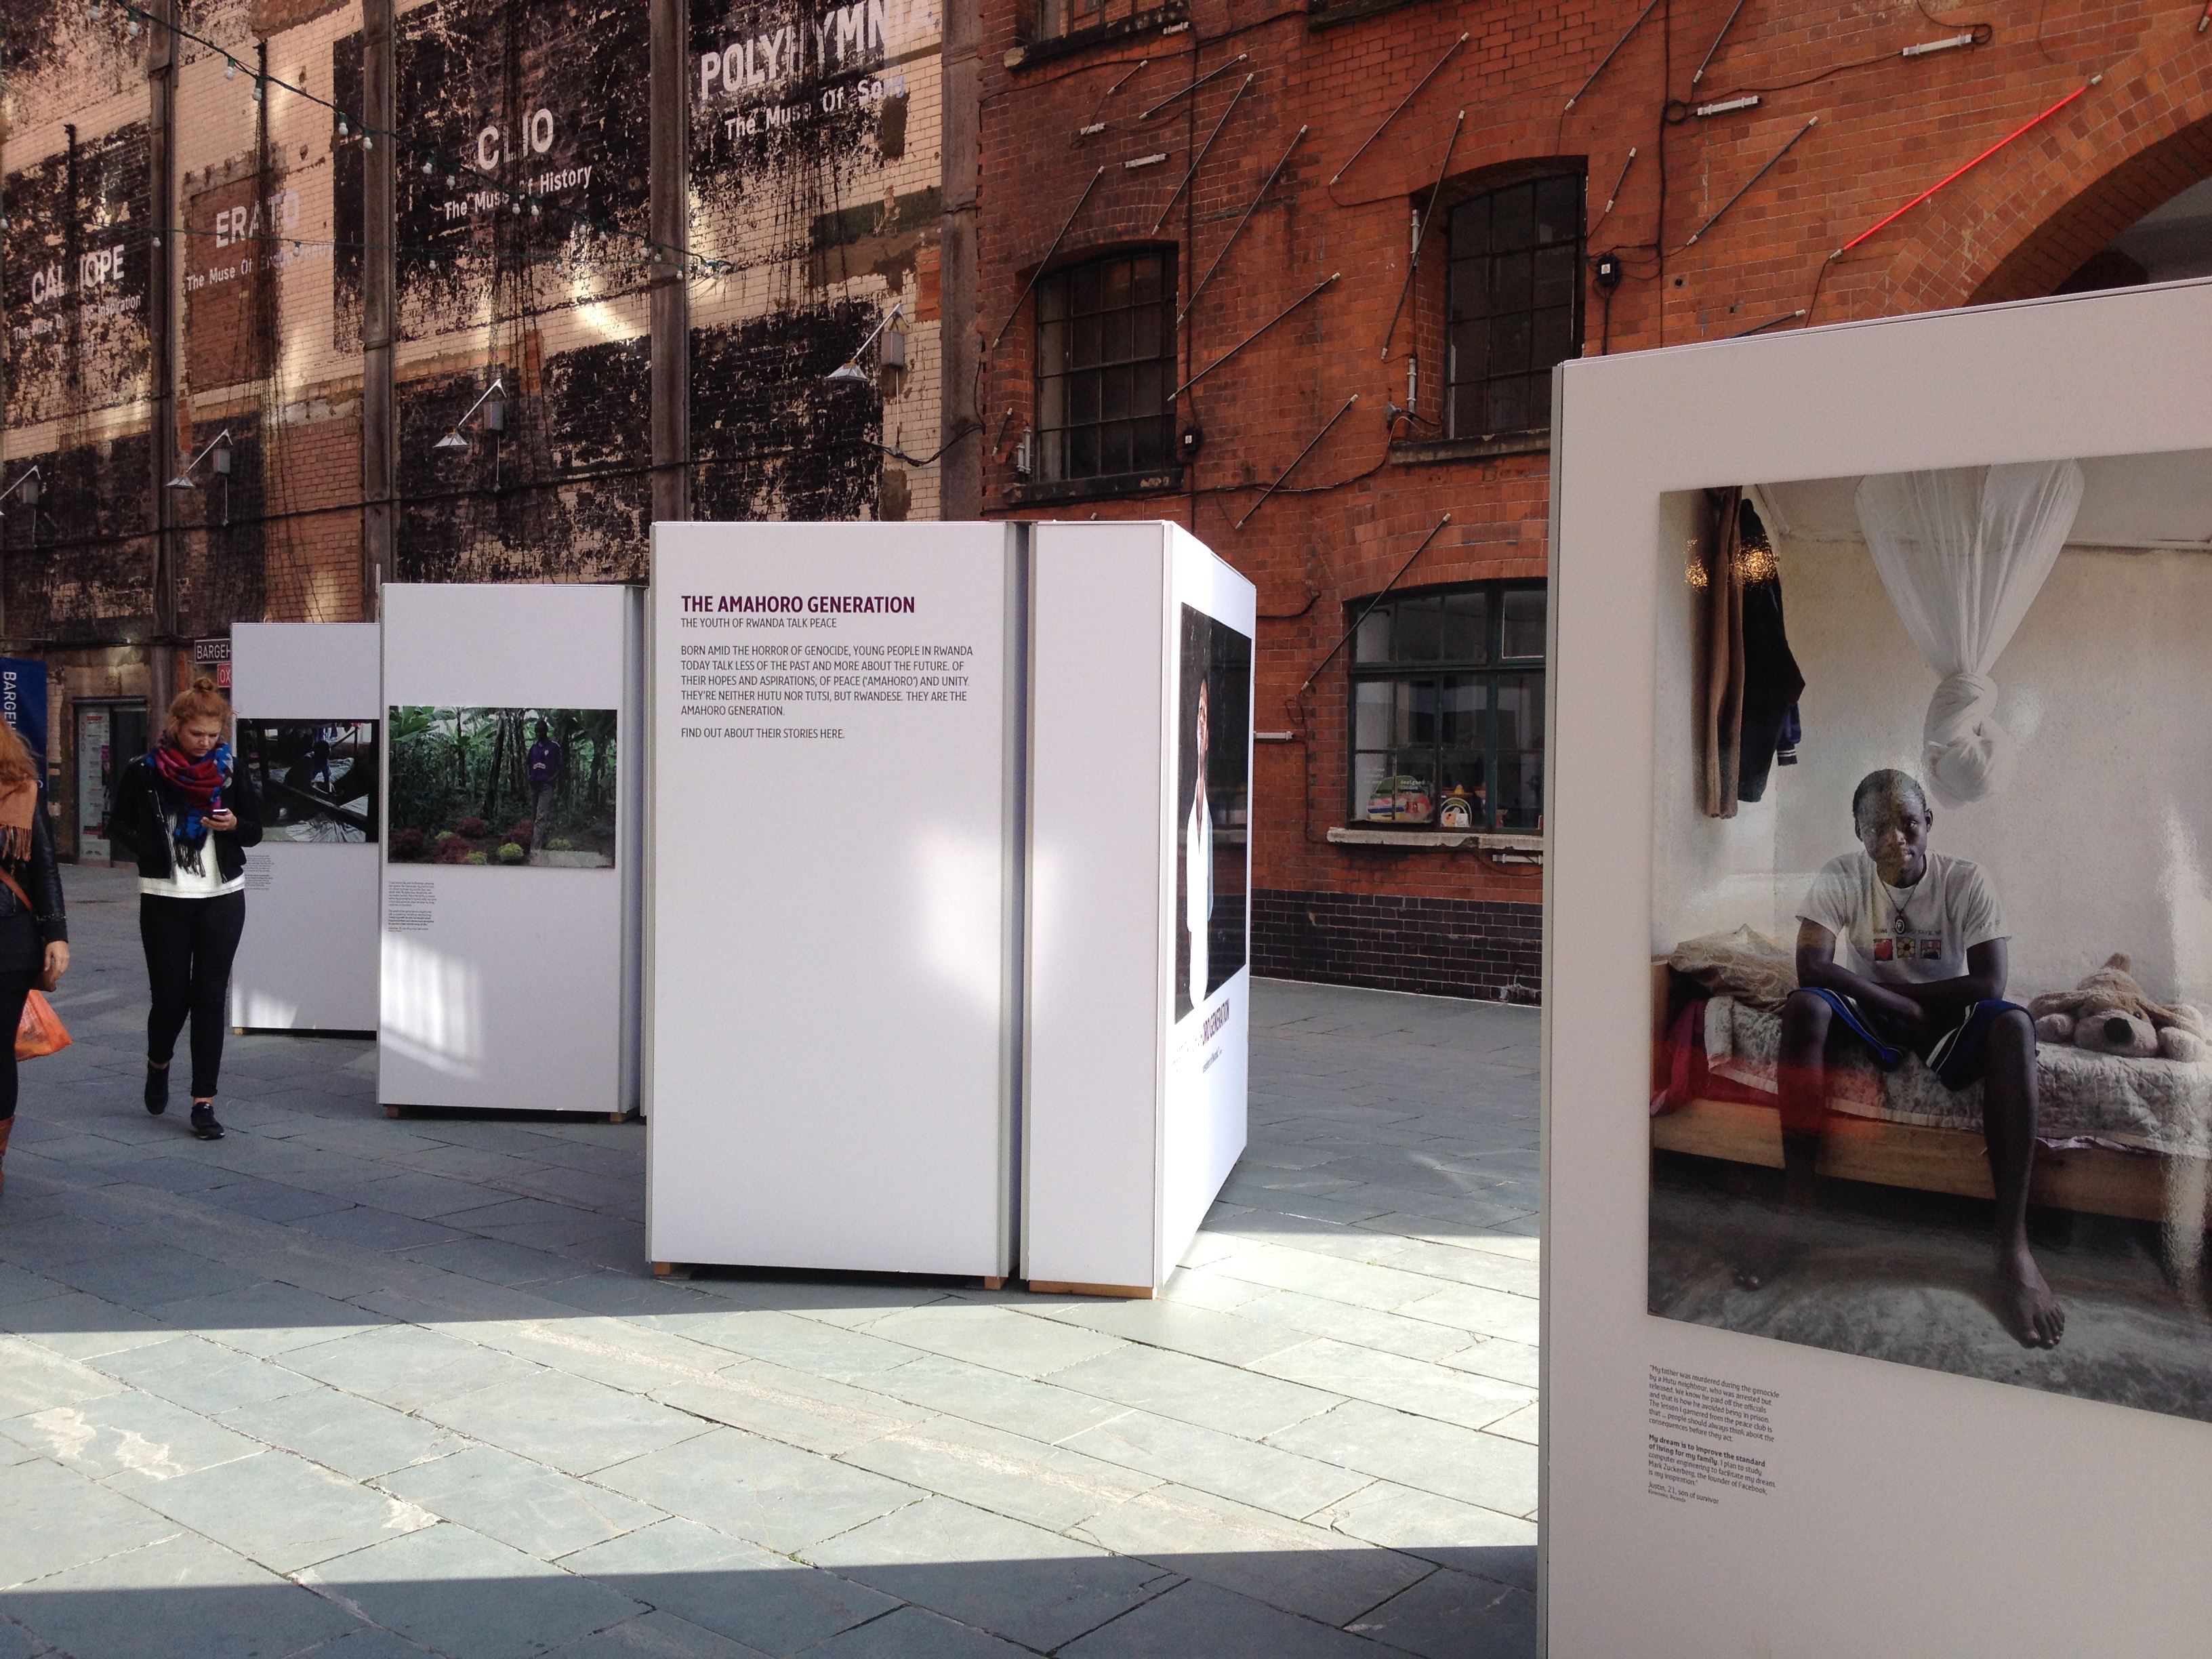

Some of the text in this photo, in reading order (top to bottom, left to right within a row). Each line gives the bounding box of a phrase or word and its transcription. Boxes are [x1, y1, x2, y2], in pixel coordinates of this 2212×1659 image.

[724, 118, 756, 140] The
[823, 86, 844, 113] Of
[857, 75, 906, 106] Song
[478, 108, 554, 170] CLIO
[445, 200, 468, 220] The
[540, 165, 592, 194] History
[187, 274, 204, 291] The
[209, 265, 235, 285] Muse
[241, 258, 252, 274] Of
[681, 596, 914, 613] THE AMAHORO GENERATION
[680, 618, 836, 628] THE YOUTH OF RWANDA TALK PEACE
[681, 645, 972, 657] BORN AMID THE HORROR OF GENOCIDE, YOUNG PEOPLE IN RWANDA
[680, 660, 964, 671] TODAY TALK LESS OF THE PAST AND MORE ABOUT THE FUTURE. OF
[681, 675, 705, 685] THEIR
[708, 676, 736, 685] HOPES
[739, 676, 757, 685] AND
[819, 676, 831, 686] OF
[834, 676, 860, 686] PEACE
[920, 676, 939, 686] AND
[718, 691, 754, 701] NEITHER
[758, 691, 781, 701] HUTU
[784, 691, 802, 701] NOR
[805, 691, 831, 702] TUTSI,
[834, 691, 851, 701] BUT
[854, 691, 903, 701] RWANDESE.
[906, 691, 928, 701] THEY
[931, 691, 947, 701] ARE
[949, 691, 966, 701] THE
[681, 705, 784, 716] AMAHORO GENERATION.
[682, 728, 844, 739] FIND OUT ABOUT THEIR STORIES HERE.
[1650, 1373, 1656, 1382] by
[1662, 1376, 1676, 1385] Hutu
[1661, 1367, 1678, 1376] father
[1721, 1380, 1740, 1391] during
[1685, 1389, 1700, 1399] know
[1660, 1401, 1678, 1412] lesson
[1709, 1412, 1723, 1421] from
[1735, 1420, 1752, 1428] peace
[1679, 1397, 1692, 1406] how
[1725, 1408, 1742, 1418] being
[1667, 1414, 1686, 1422] people
[1746, 1431, 1763, 1439] about
[1689, 1426, 1706, 1435] before
[1708, 1431, 1721, 1441] they
[1649, 1434, 1658, 1443] My
[1659, 1436, 1679, 1446] dream
[1656, 1444, 1673, 1456] living
[1675, 1448, 1684, 1456] for
[1723, 1460, 1736, 1469] plan
[1745, 1466, 1761, 1476] study
